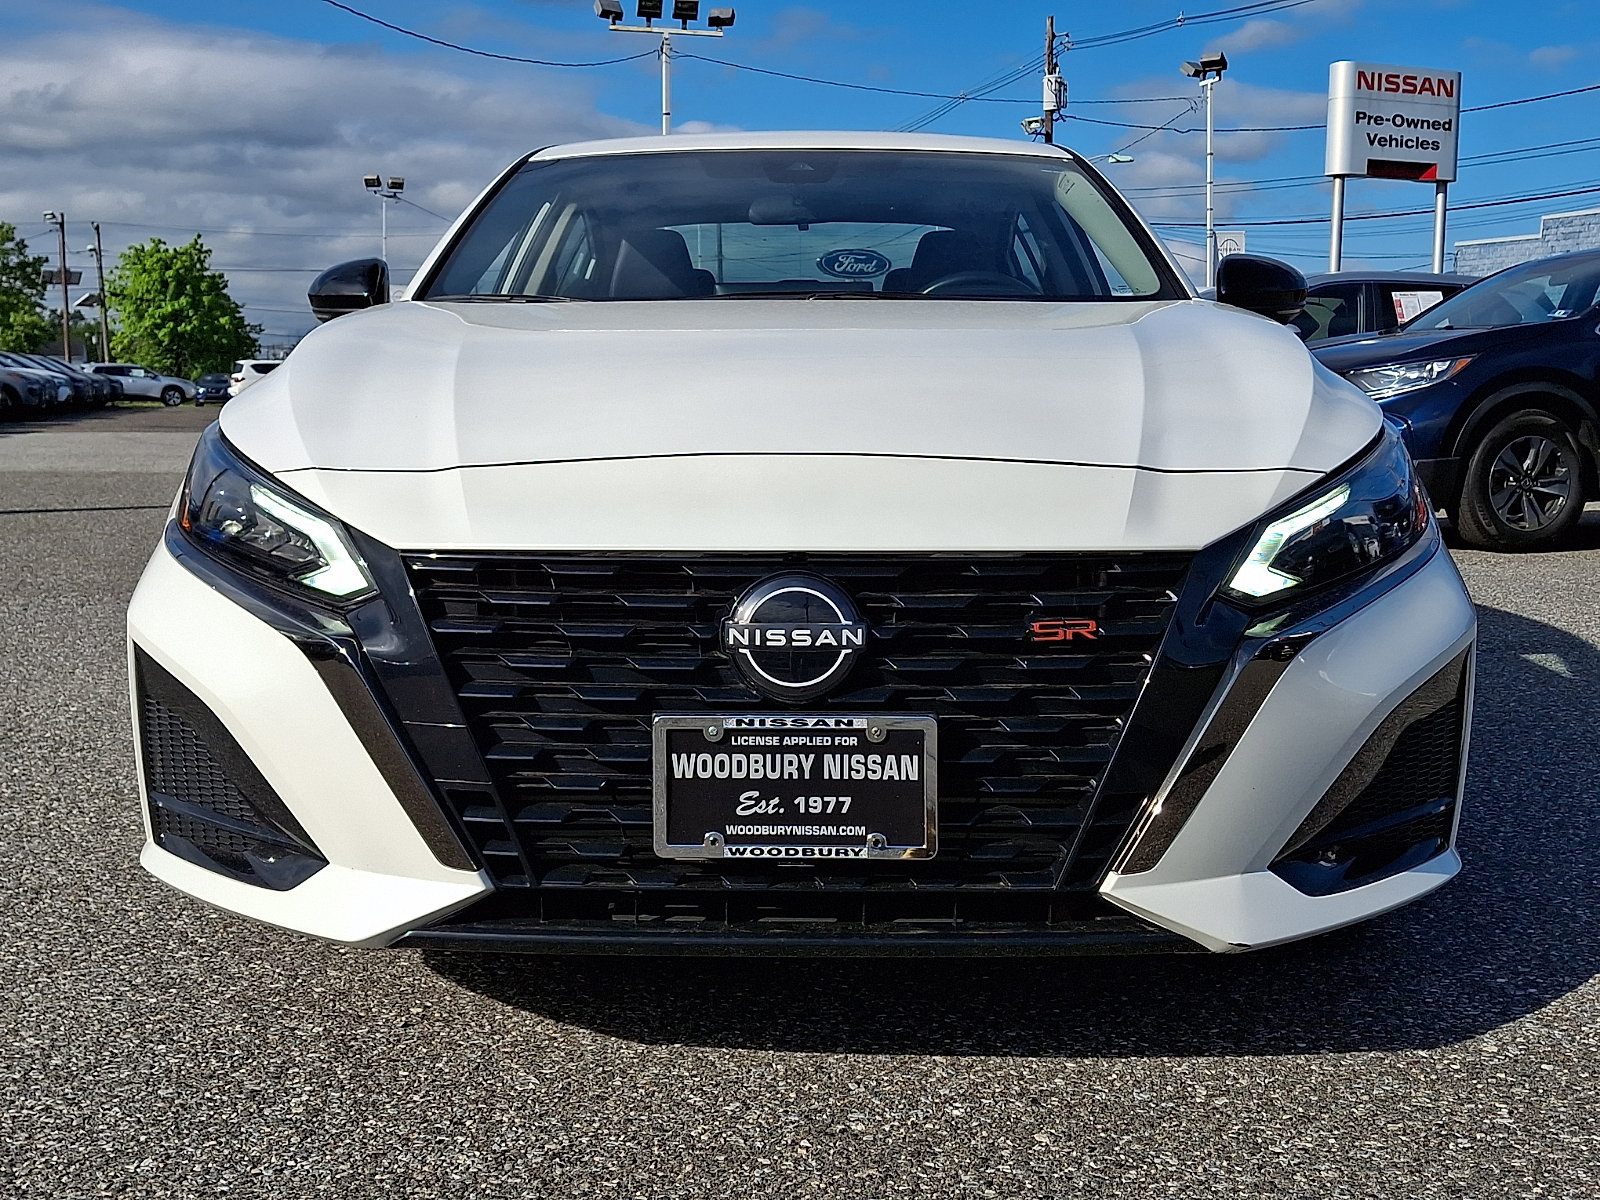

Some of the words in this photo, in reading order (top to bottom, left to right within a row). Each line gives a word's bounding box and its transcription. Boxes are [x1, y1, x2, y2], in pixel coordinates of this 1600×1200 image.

[1357, 70, 1455, 98] NISSAN
[1355, 110, 1453, 132] Pre-Owned
[1366, 132, 1441, 151] Vehicles
[834, 254, 878, 273] Ford
[728, 627, 864, 647] NISSAN
[1031, 620, 1097, 641] SR
[735, 718, 855, 727] NISSAN
[731, 736, 780, 746] LICENSE
[783, 736, 832, 746] APPLIED
[834, 736, 858, 746] FOR
[671, 753, 815, 779] WOODBURY
[823, 753, 919, 781] NISSAN
[736, 791, 785, 816] Est.
[794, 796, 852, 814] 1977
[725, 825, 866, 836] WOODBURYNISSAN.COM
[727, 847, 864, 857] WOODBURY
